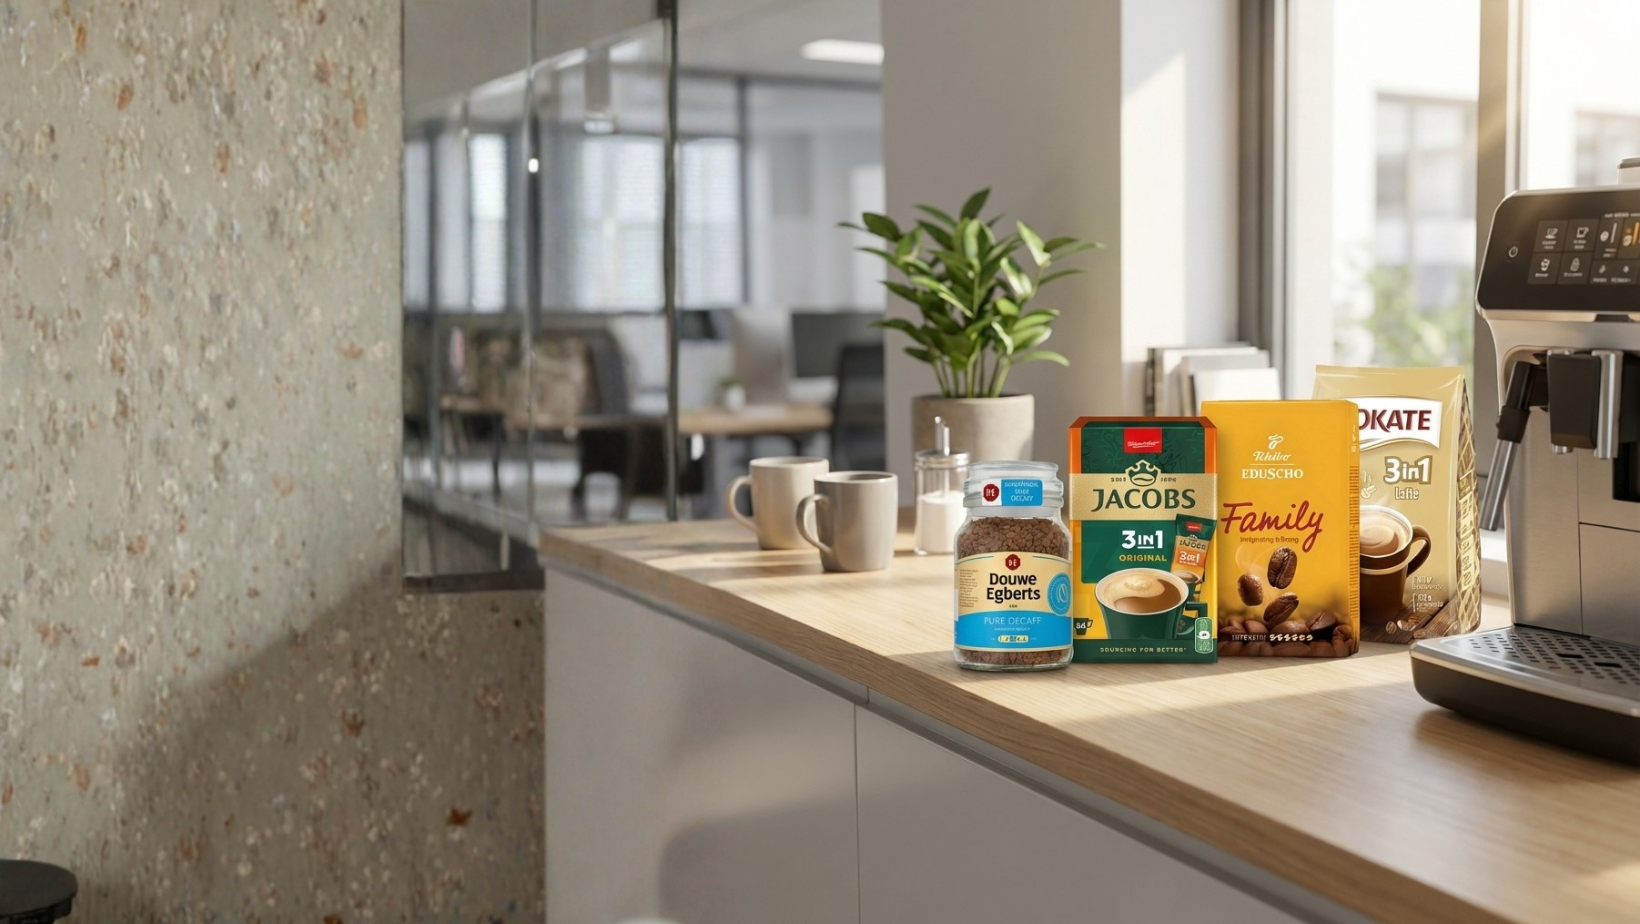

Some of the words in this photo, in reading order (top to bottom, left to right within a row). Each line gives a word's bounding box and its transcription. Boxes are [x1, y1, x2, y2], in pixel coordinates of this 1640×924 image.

[1241, 468, 1304, 480] EDUSCHO
[1384, 457, 1431, 483] 3in1
[1090, 488, 1196, 513] JACOBS
[1220, 500, 1324, 553] Family
[1118, 554, 1167, 562] ORIGINAL
[989, 573, 1037, 586] Douwe
[986, 586, 1041, 604] Egberts
[984, 616, 1005, 625] PURE
[1008, 616, 1042, 625] DECAFF
